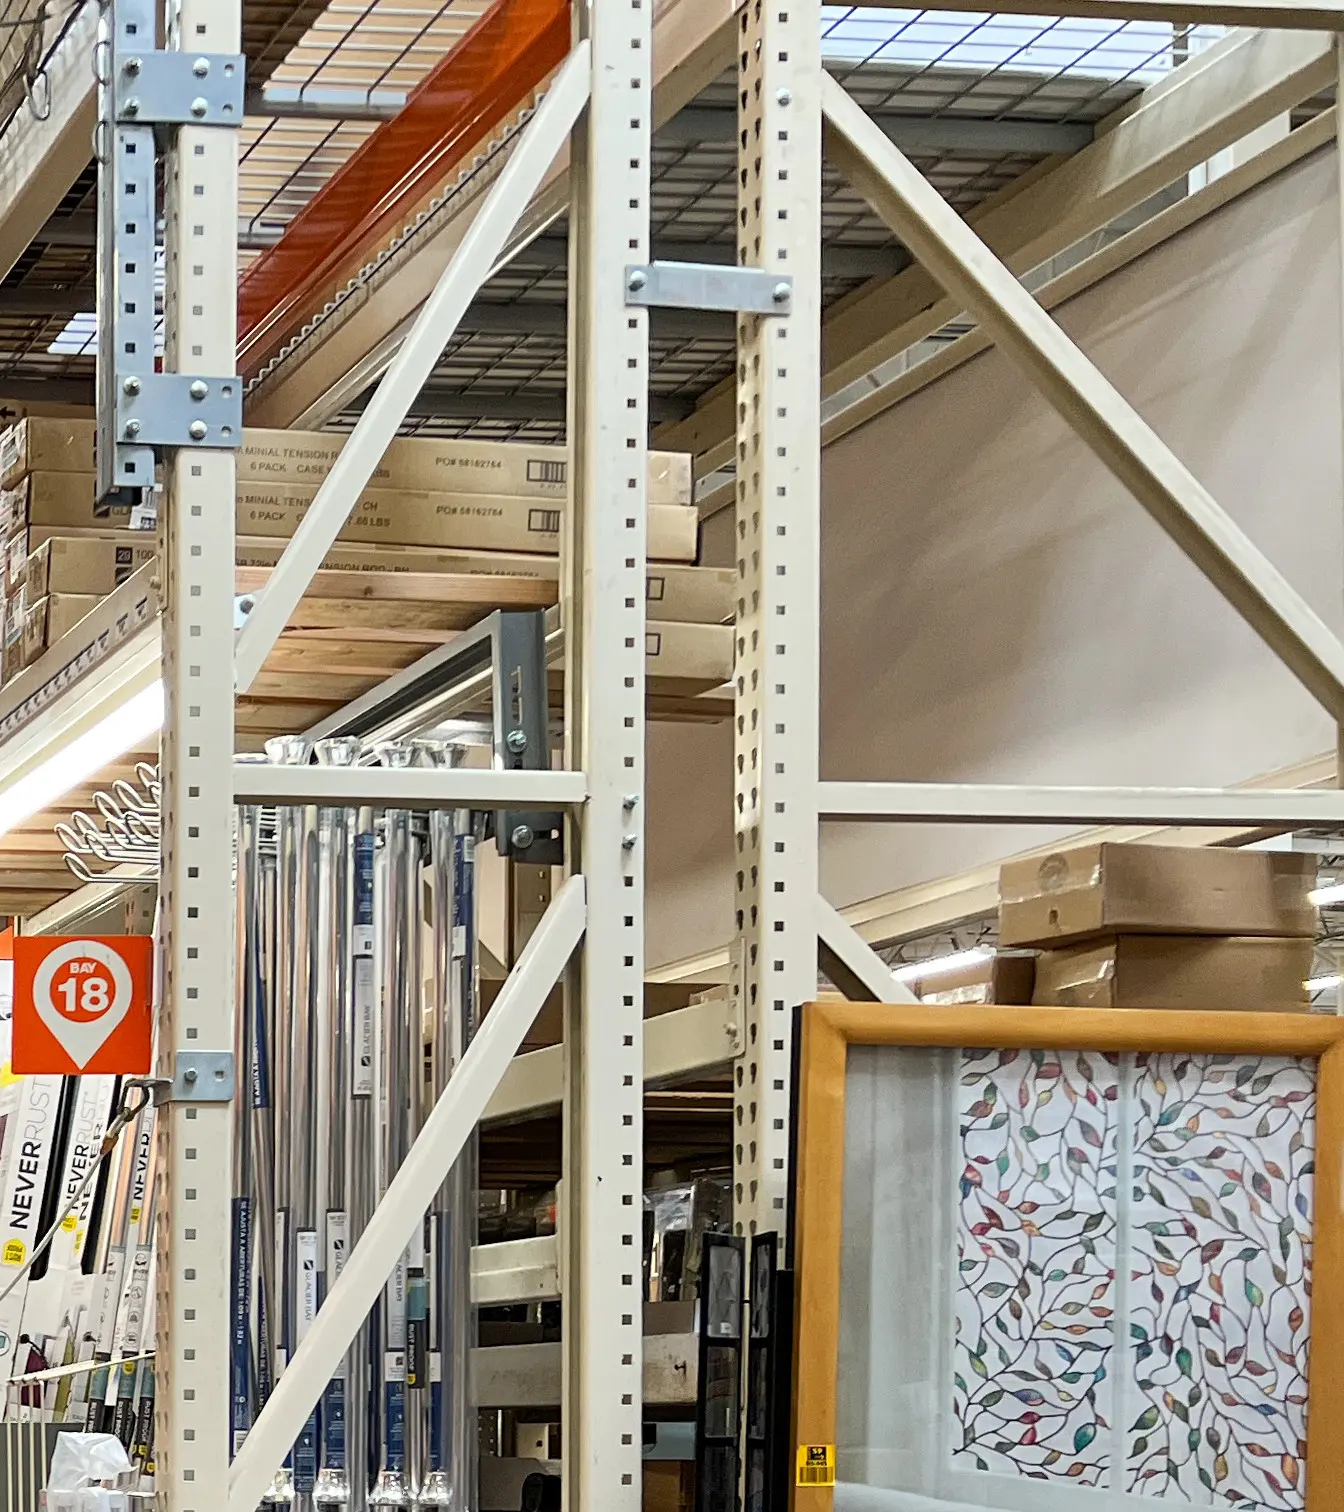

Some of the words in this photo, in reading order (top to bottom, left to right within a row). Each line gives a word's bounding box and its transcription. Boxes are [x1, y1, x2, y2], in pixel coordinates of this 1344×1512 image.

[258, 462, 288, 473] PACK
[296, 463, 324, 475] CASE
[69, 961, 98, 974] BAY
[57, 976, 111, 1013] 18
